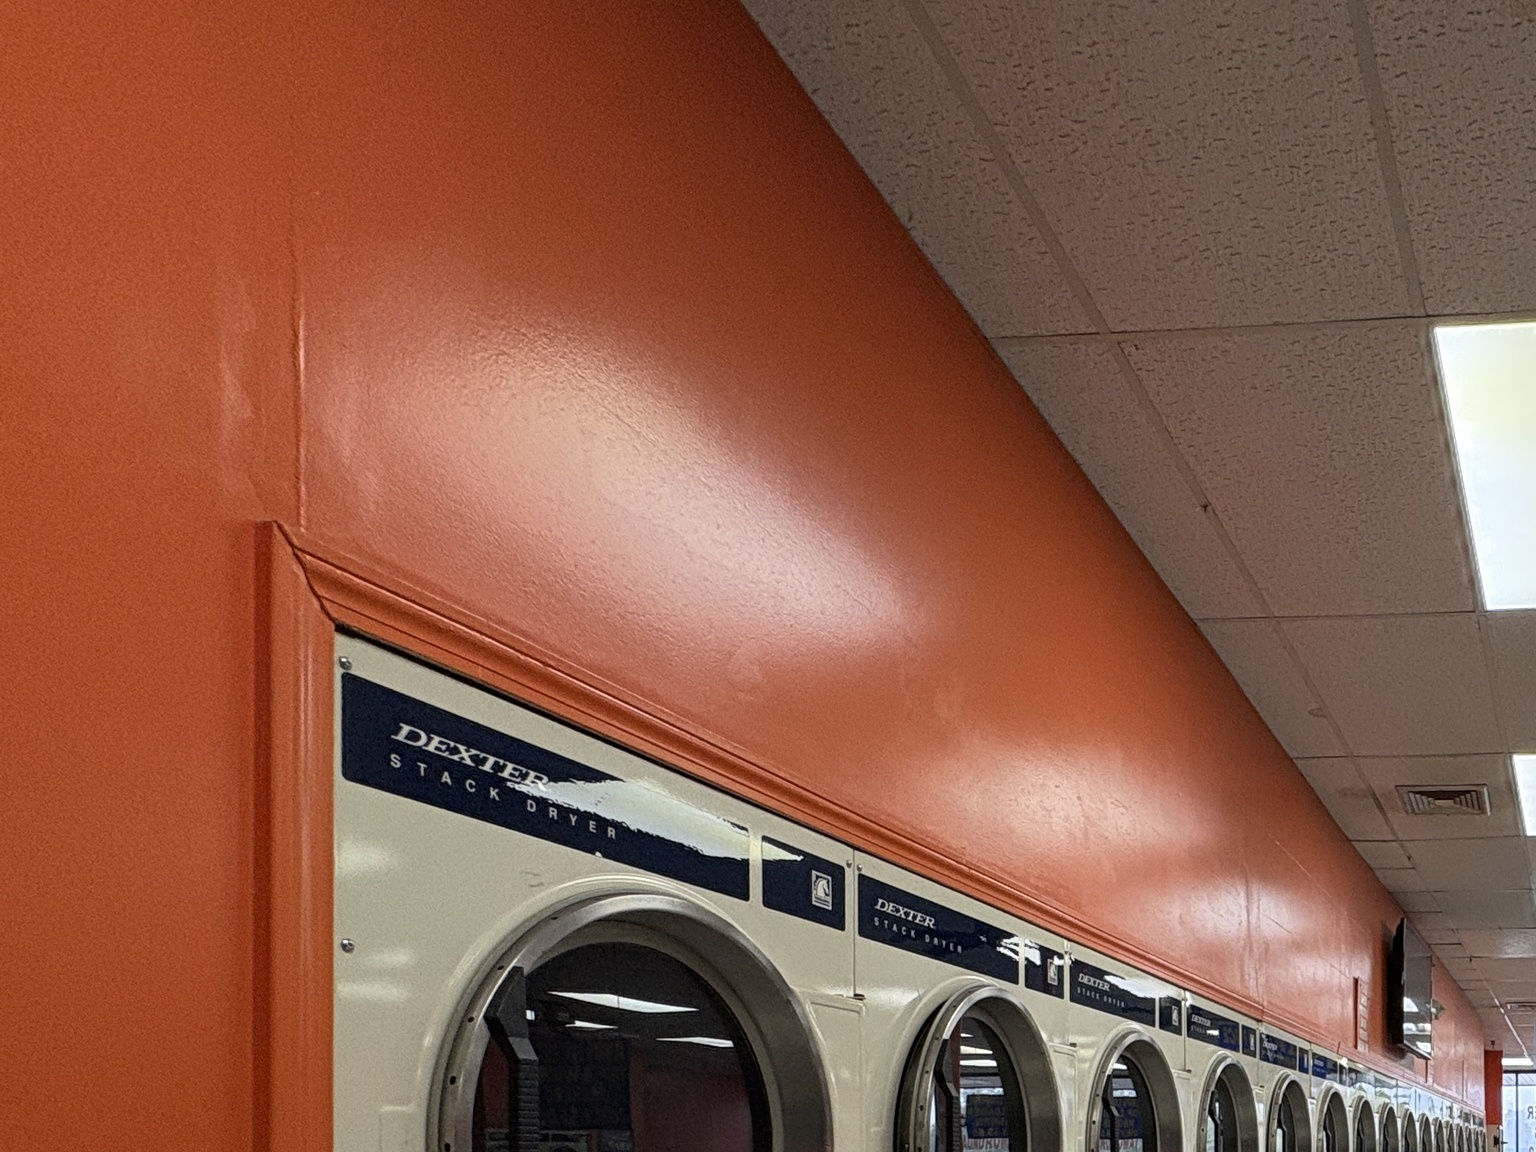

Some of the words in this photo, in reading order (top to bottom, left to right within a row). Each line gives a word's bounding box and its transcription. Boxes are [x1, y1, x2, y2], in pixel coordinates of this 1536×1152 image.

[391, 722, 549, 792] DEXTER
[390, 754, 500, 801] STACK
[526, 799, 617, 840] DRYER
[874, 898, 937, 930] DEXTER
[873, 916, 916, 939] STACK
[925, 934, 962, 954] DRYER
[1078, 973, 1111, 992] DEXTER
